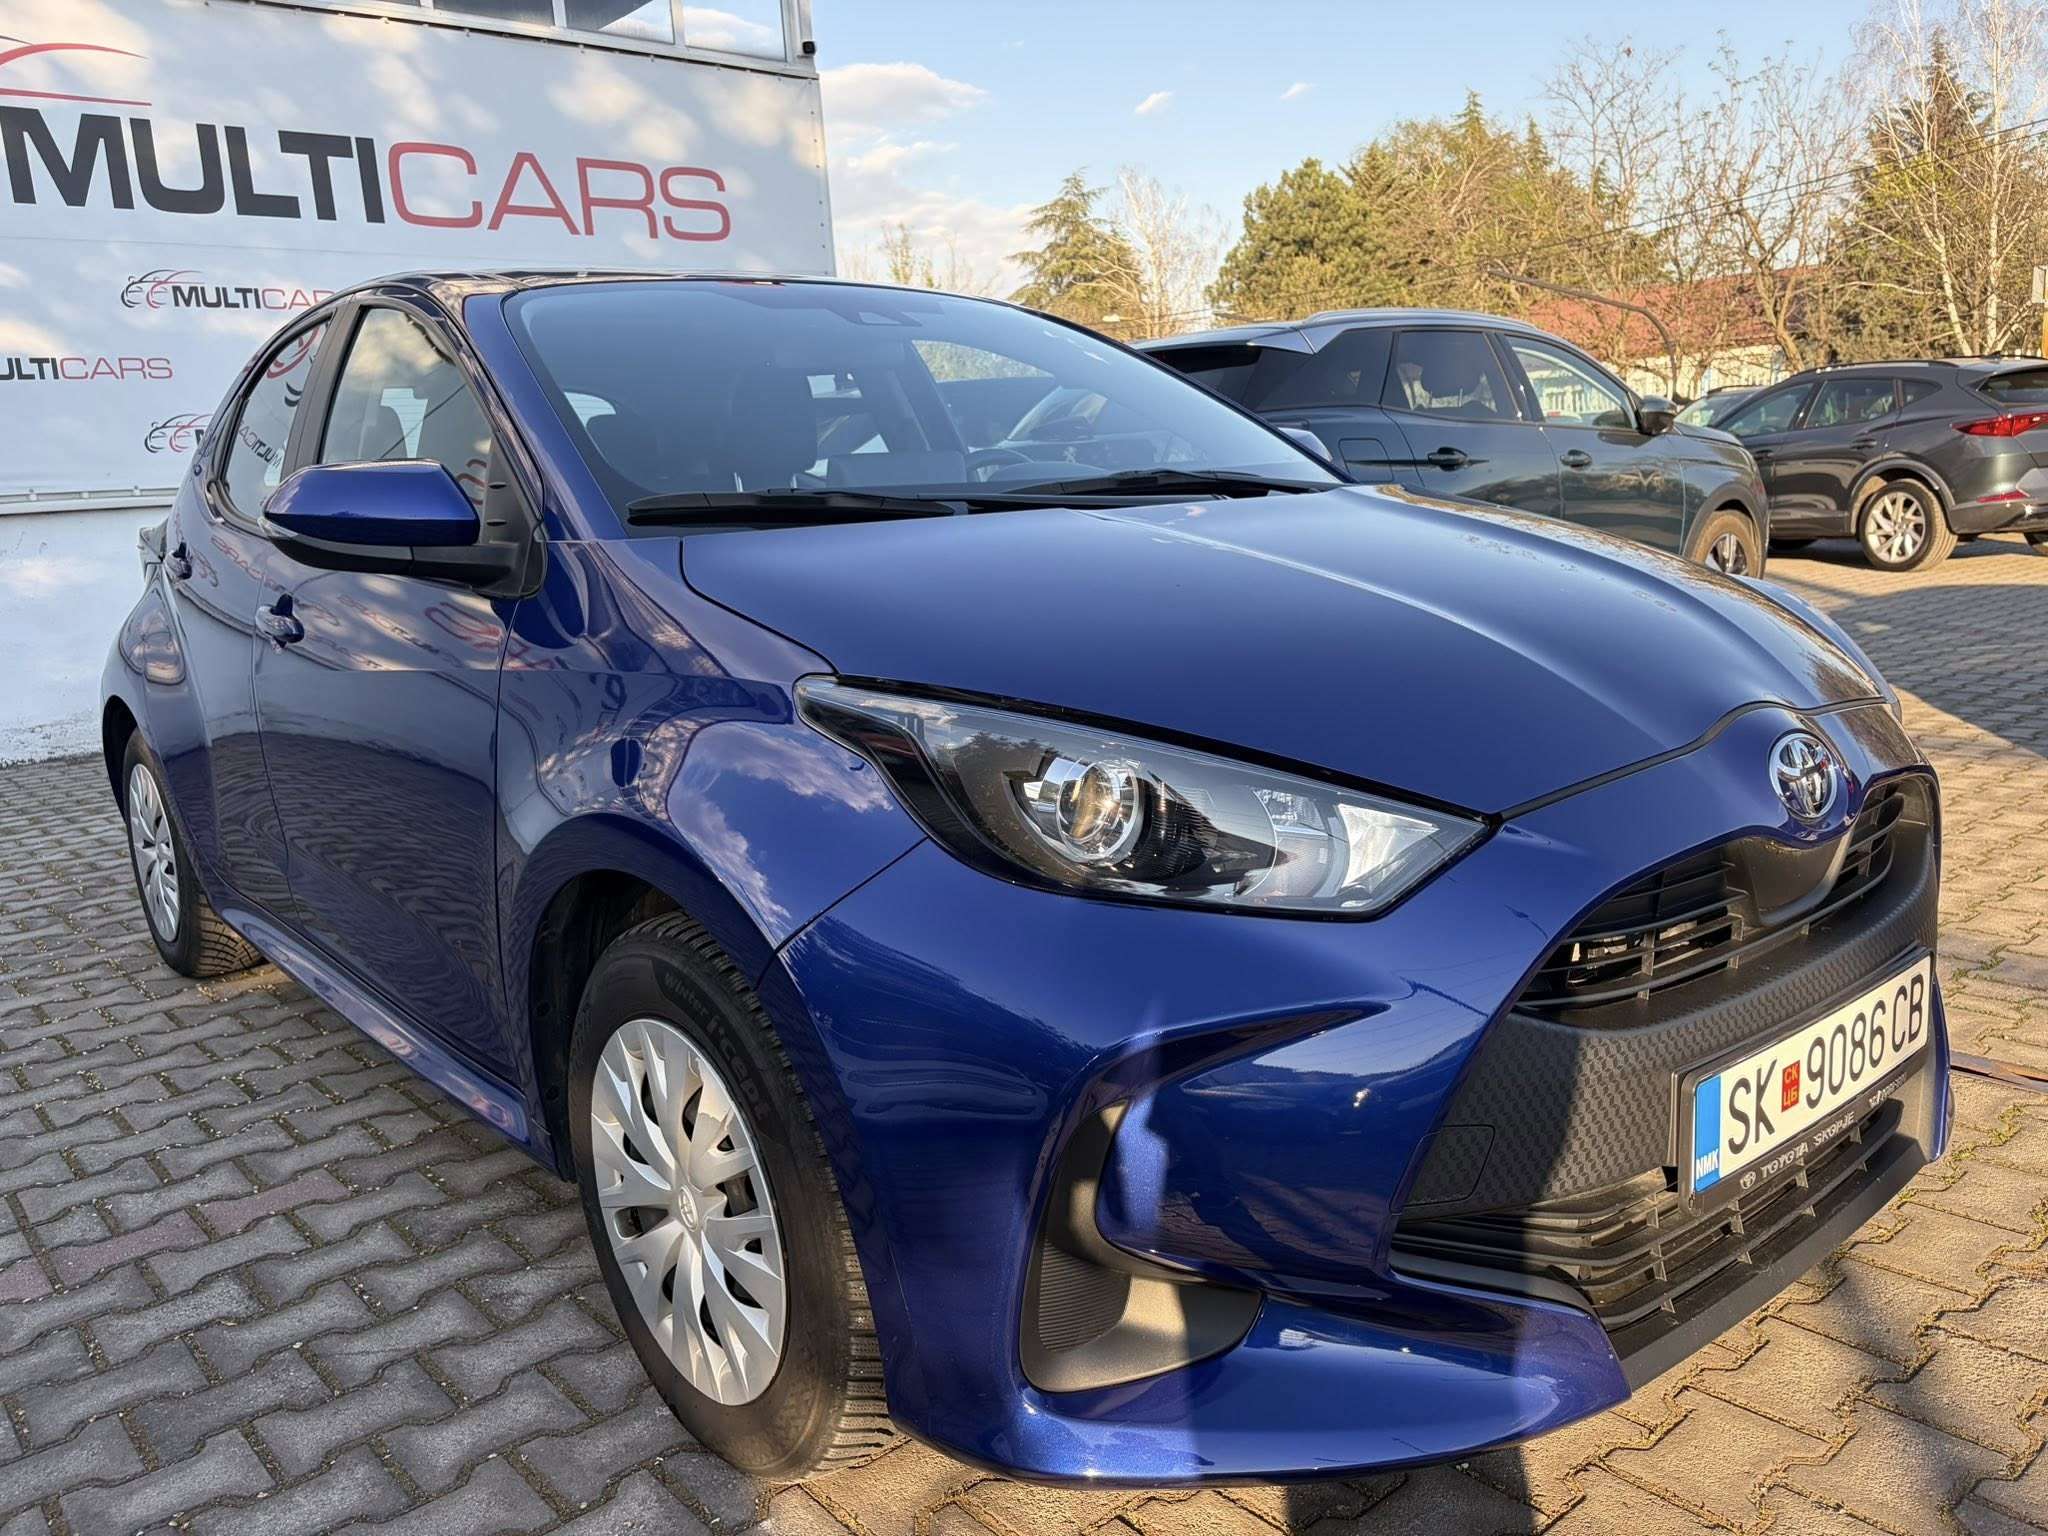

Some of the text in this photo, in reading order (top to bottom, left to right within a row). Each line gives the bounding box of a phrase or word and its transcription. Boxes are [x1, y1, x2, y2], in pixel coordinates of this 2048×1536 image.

[0, 106, 731, 241] MULTICARS
[0, 357, 173, 381] ULTICARS
[1728, 973, 1924, 1155] SK 9086 CB
[1696, 1149, 1719, 1179] NMK
[1760, 1111, 1855, 1178] TOYOTA SKOPJE
